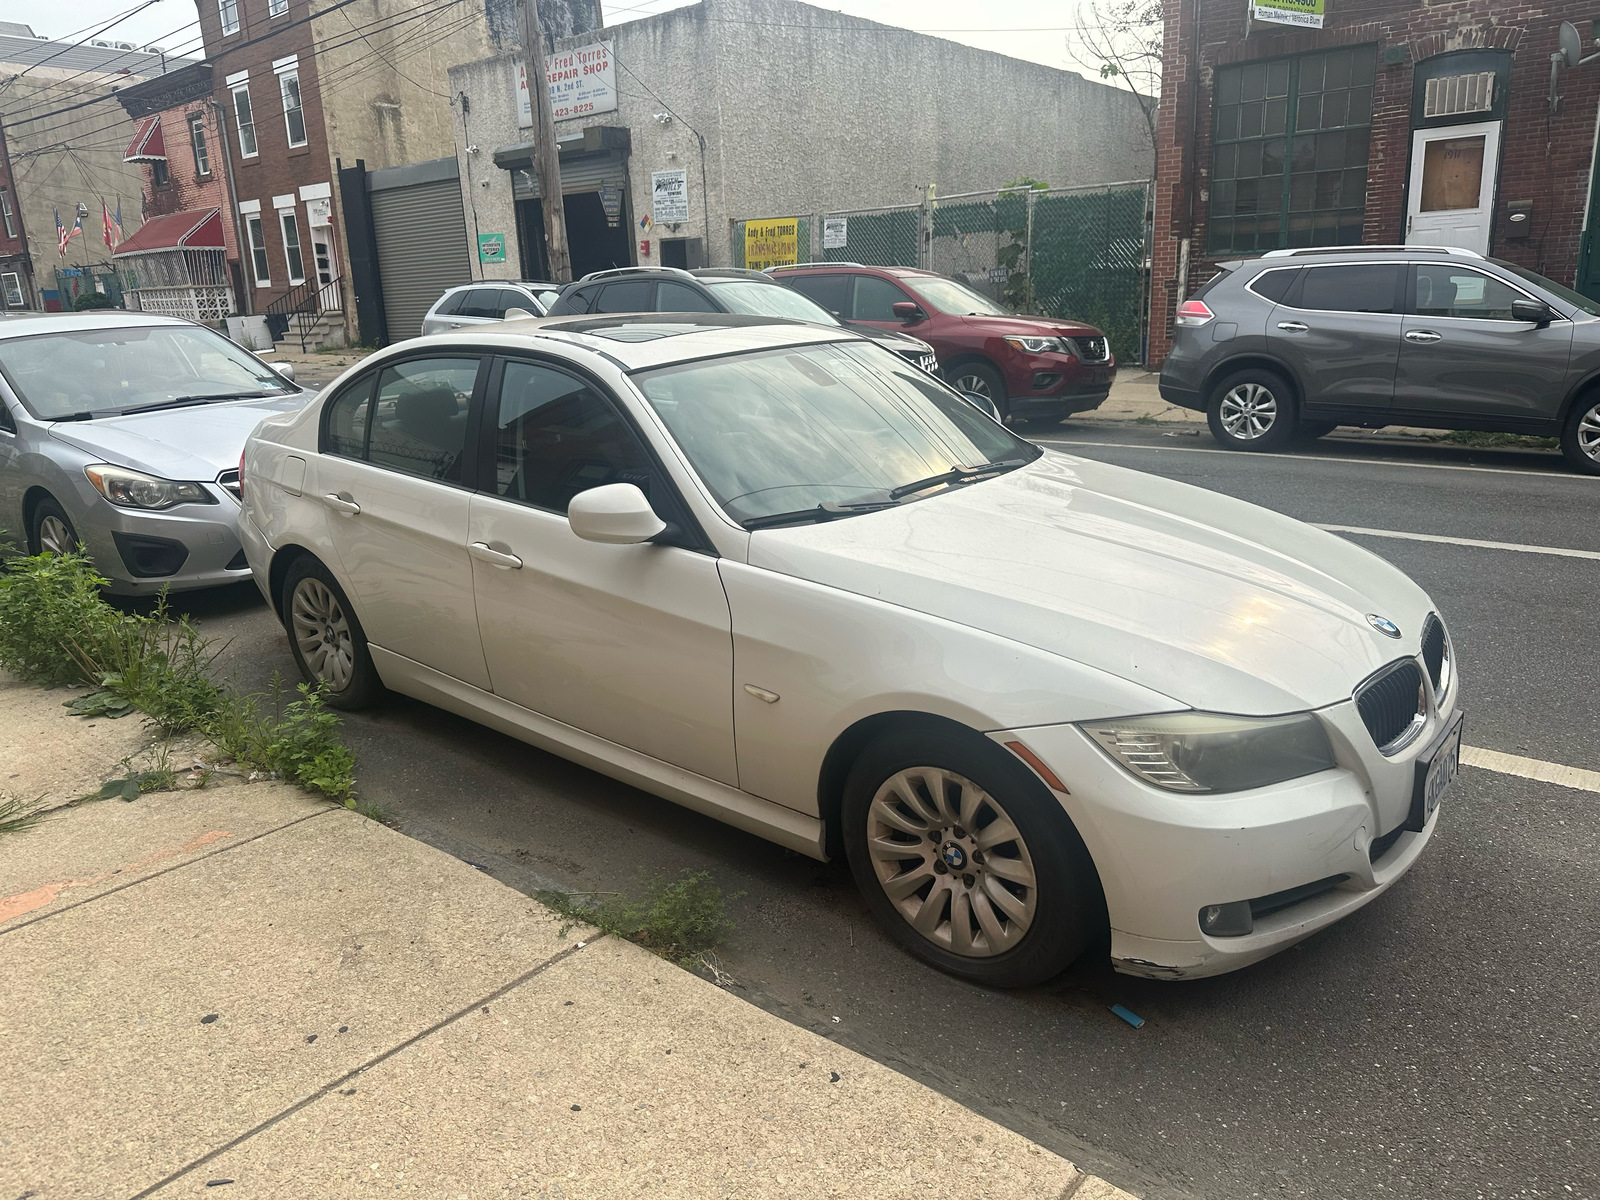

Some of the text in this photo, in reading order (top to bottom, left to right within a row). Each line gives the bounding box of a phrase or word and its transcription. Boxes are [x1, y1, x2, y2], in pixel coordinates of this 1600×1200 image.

[1258, 8, 1273, 17] Roman
[554, 53, 574, 70] Fred
[577, 48, 607, 64] Torres
[547, 61, 608, 83] REPAIR SHOP
[564, 82, 574, 91] 2nd
[552, 102, 594, 117] -423-8225
[748, 224, 795, 239] Andy & Fred TORRES
